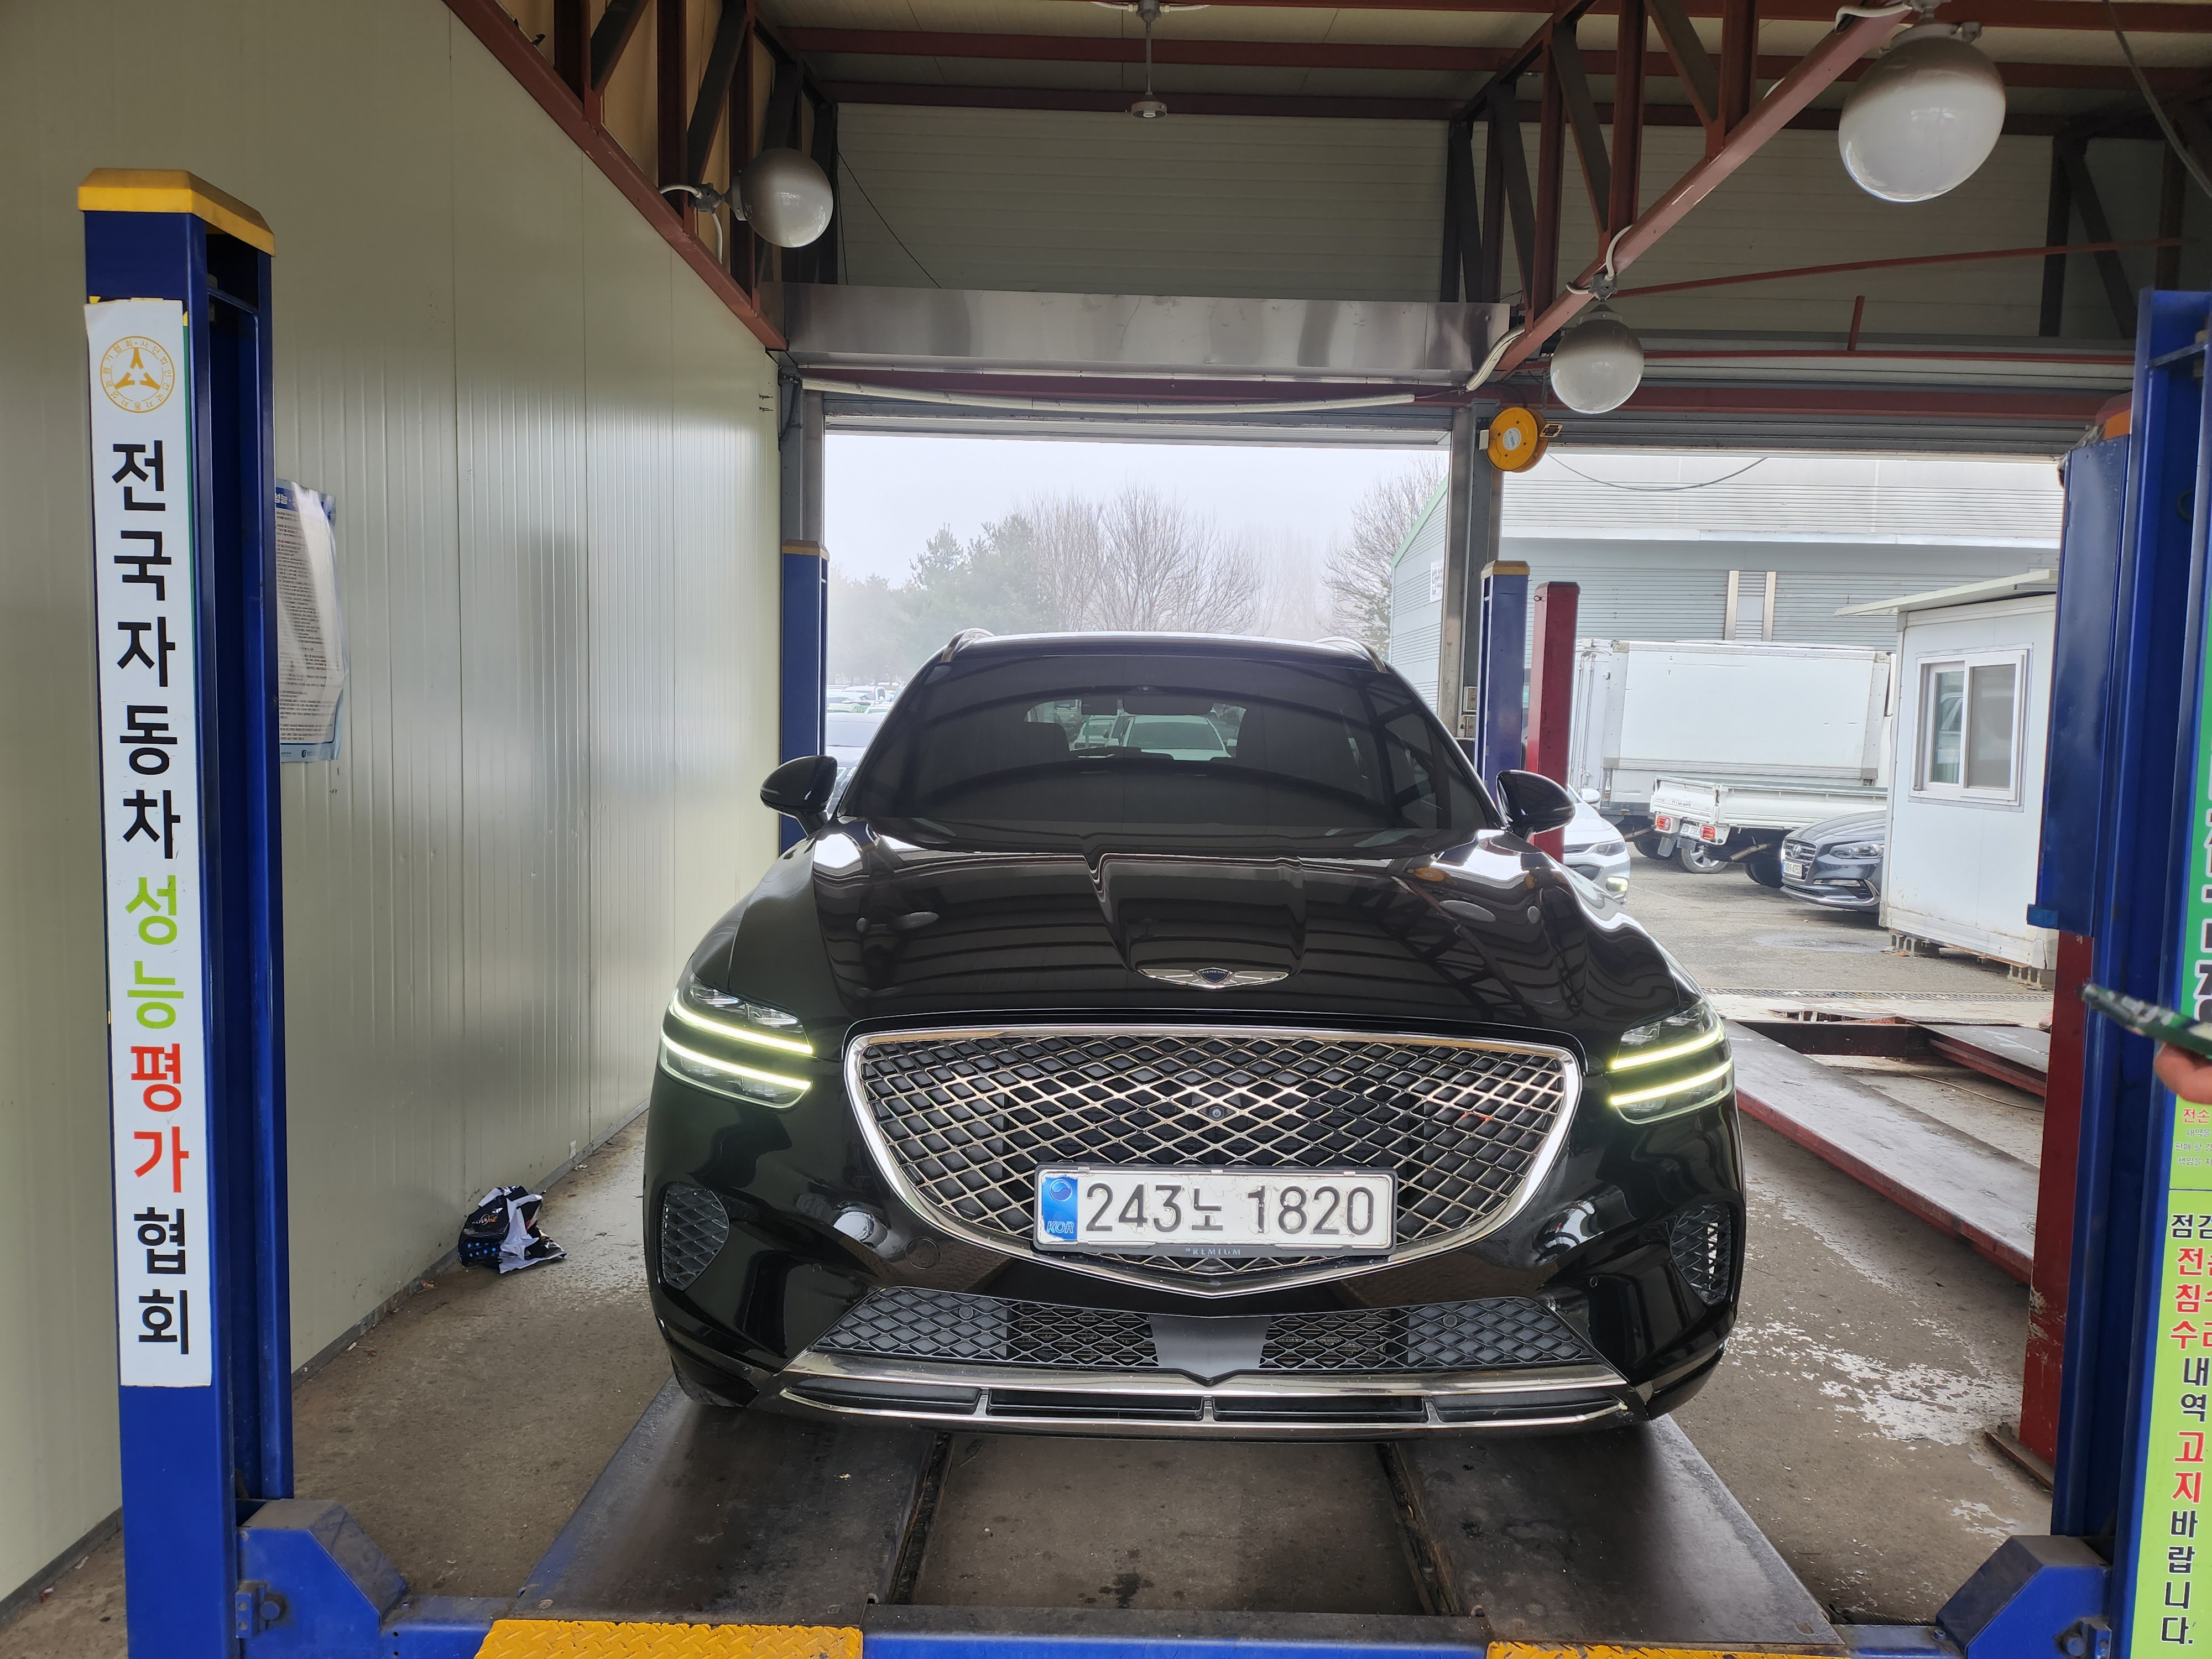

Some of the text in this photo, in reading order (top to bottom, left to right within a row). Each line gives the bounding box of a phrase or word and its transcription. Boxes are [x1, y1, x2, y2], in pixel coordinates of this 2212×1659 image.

[2176, 1142, 2191, 1151] 판매
[2178, 1157, 2201, 1166] 책임을
[1086, 1182, 1374, 1235] 243노 1820
[1046, 1220, 1074, 1234] KOR
[2177, 1248, 2212, 1276] 전
[2174, 1284, 2212, 1313] 침
